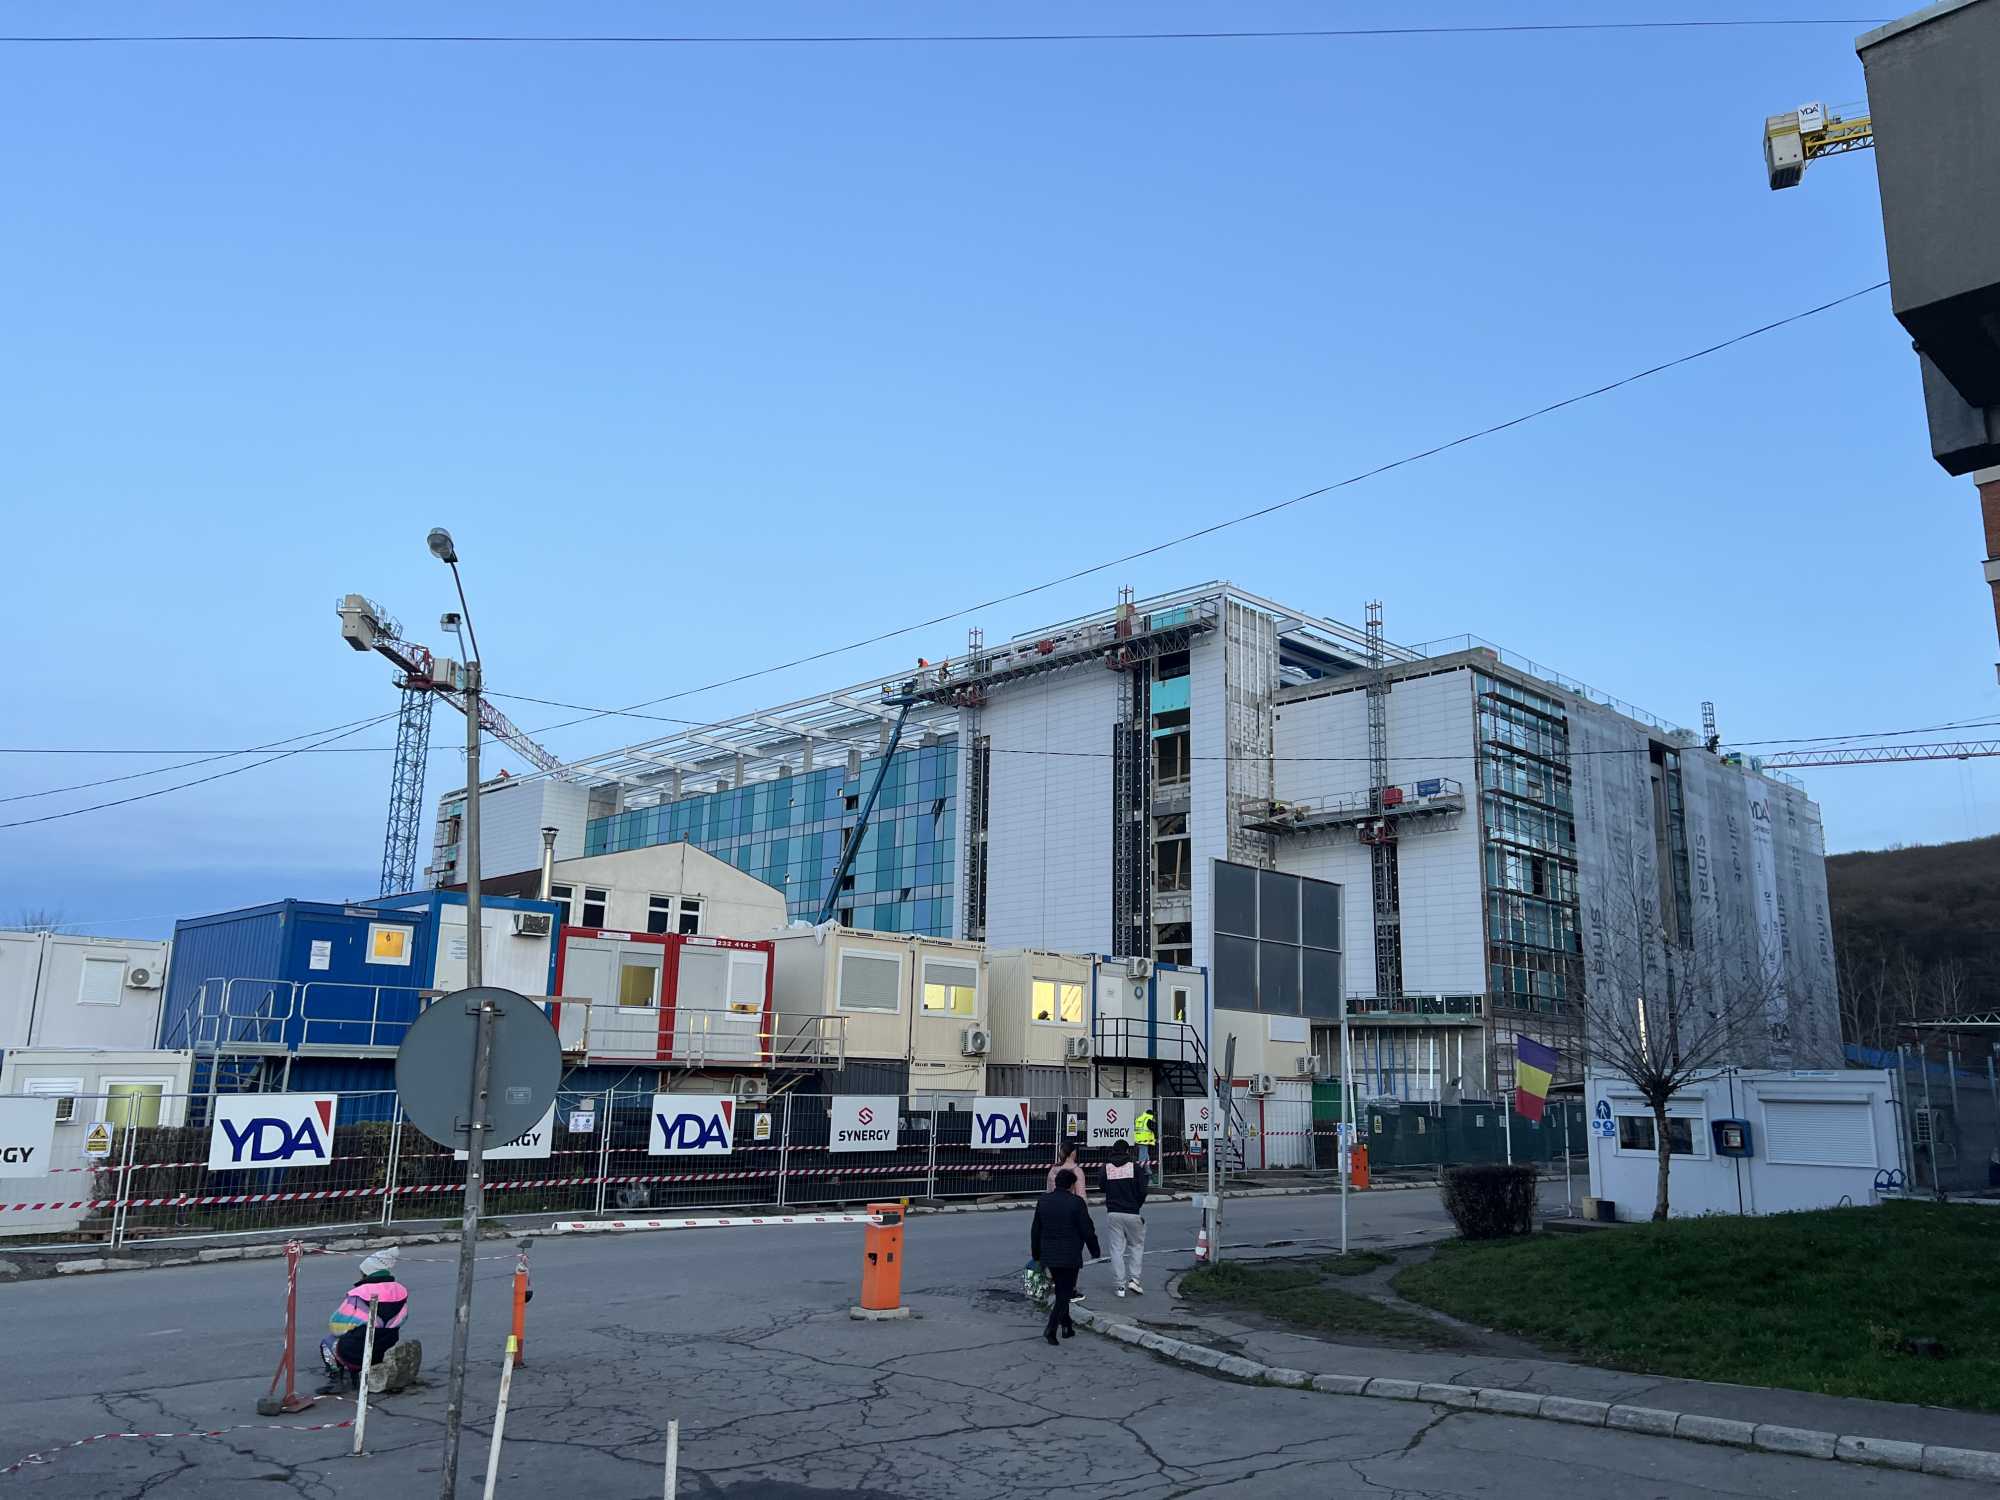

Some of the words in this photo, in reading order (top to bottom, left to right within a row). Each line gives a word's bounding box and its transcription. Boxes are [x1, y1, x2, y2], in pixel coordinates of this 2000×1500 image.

[1800, 106, 1819, 116] YDA
[1748, 800, 1770, 823] YDA
[656, 1113, 728, 1149] YDA
[838, 1129, 890, 1142] SYNERGY
[975, 1113, 1026, 1144] YDA
[1093, 1127, 1130, 1138] SYNERGY
[219, 1117, 325, 1162] YDA
[0, 1146, 34, 1163] GY
